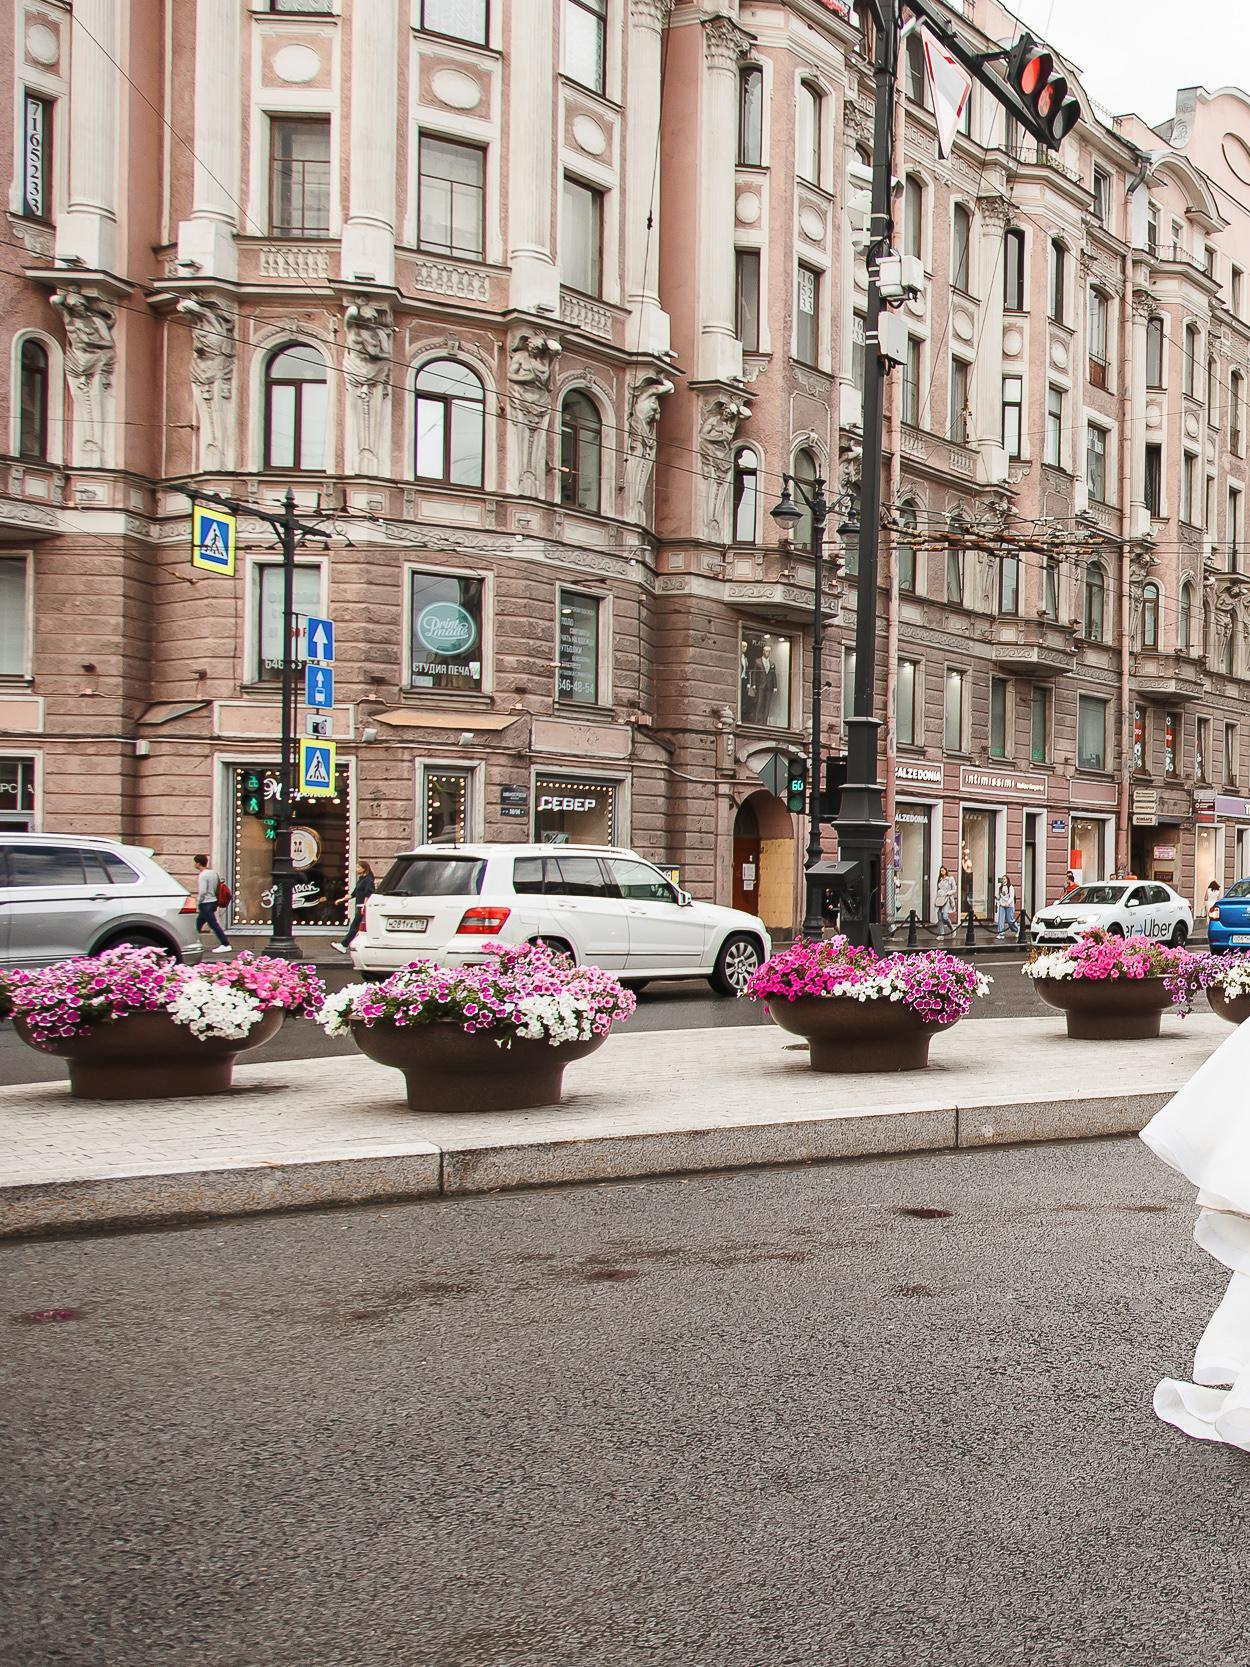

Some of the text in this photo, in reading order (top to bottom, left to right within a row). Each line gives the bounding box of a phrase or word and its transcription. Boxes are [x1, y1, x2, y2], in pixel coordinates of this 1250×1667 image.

[560, 644, 583, 654] УТБОЛКИ
[413, 662, 475, 677] СТУДИЯ ПЕЧАТ
[792, 780, 804, 791] 60
[540, 795, 596, 812] СЕВЕР
[895, 812, 928, 824] ALZEDONIA
[1143, 919, 1171, 937] Uber
